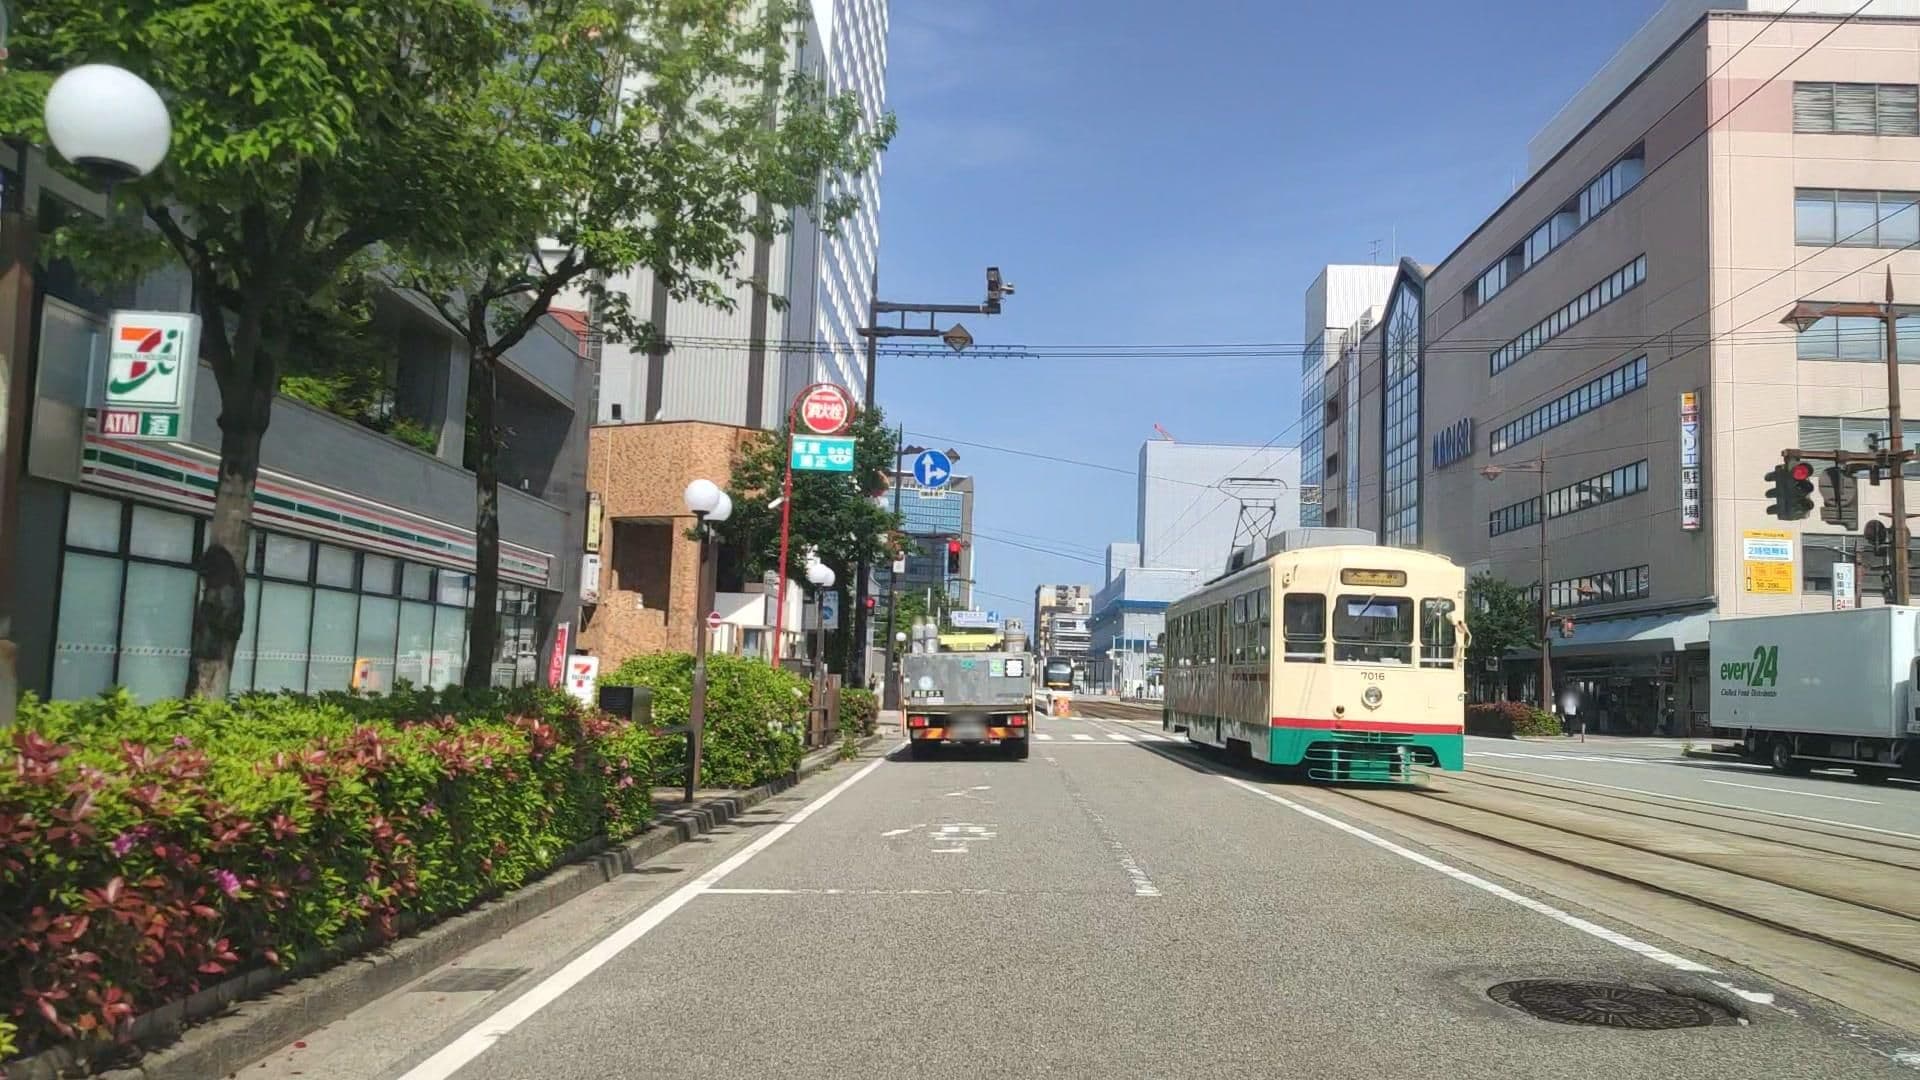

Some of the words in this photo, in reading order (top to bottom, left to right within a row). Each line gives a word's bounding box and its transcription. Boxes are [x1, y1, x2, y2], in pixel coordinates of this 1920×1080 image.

[104, 413, 137, 432] ATM
[148, 415, 170, 435] 酒
[1683, 471, 1699, 518] 駐車場
[1360, 671, 1385, 681] 7016
